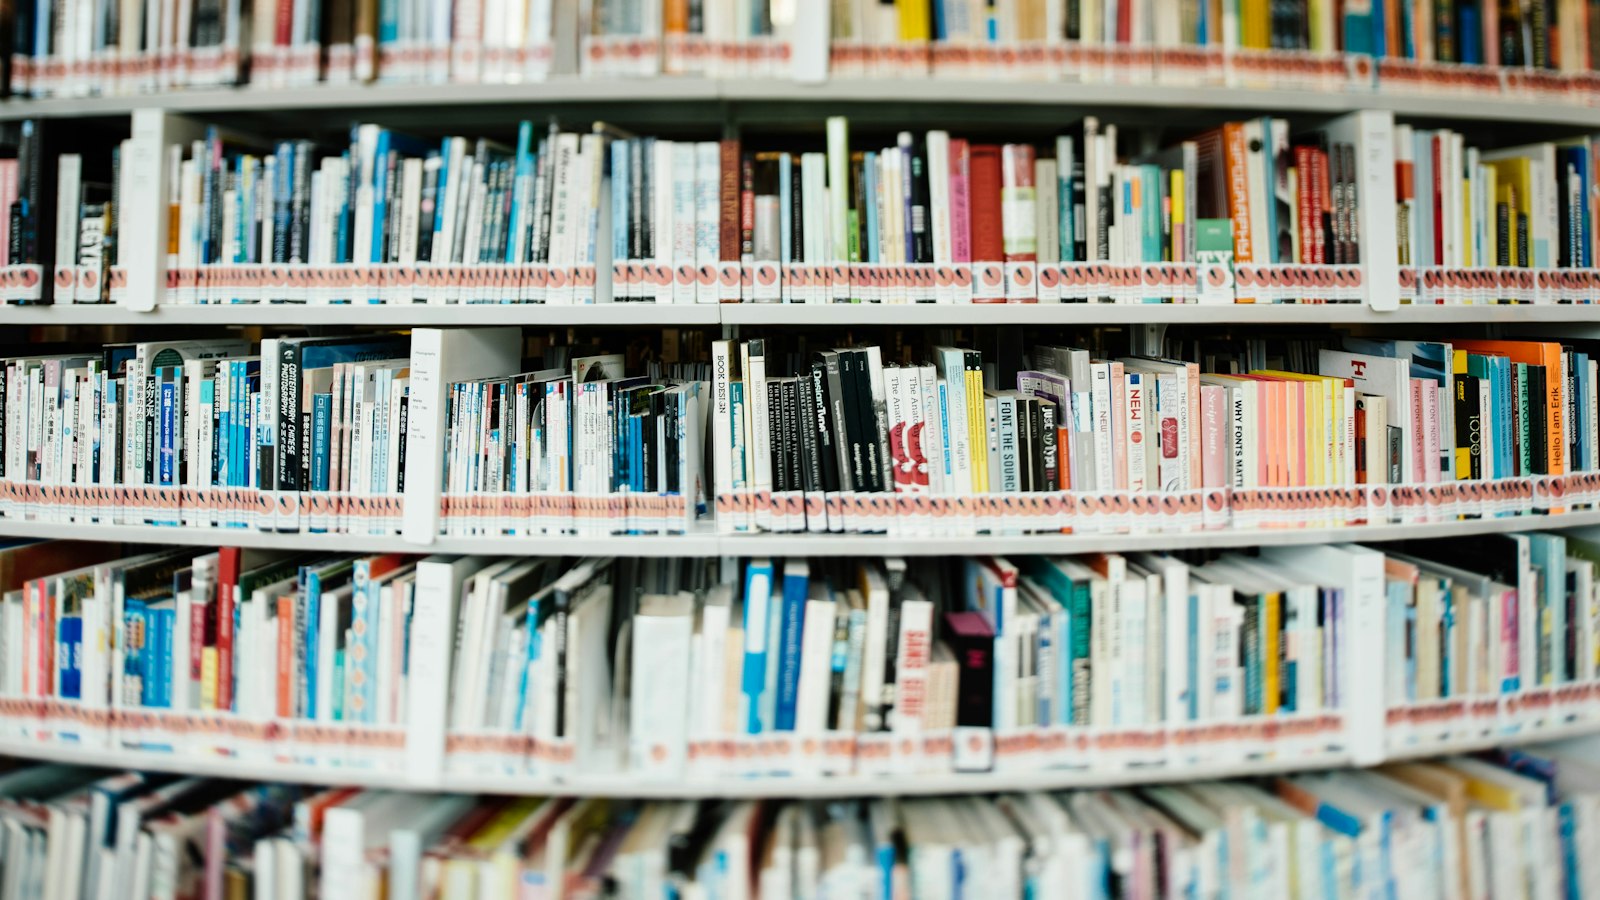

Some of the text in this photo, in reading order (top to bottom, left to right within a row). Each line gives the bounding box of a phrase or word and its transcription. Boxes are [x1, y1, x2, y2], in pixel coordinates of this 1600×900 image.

[717, 355, 727, 415] BOOK DESIGN
[891, 376, 900, 395] The
[909, 376, 918, 395] The
[925, 376, 934, 394] The
[1551, 387, 1560, 408] Erik
[287, 362, 297, 455] CONTEMPORARY CHINESE
[806, 396, 814, 429] ELEMENTS
[893, 398, 903, 438] Anatomy
[911, 397, 922, 438] Anatomy
[926, 395, 936, 440] Geometry
[1001, 402, 1012, 429] FONT.
[1130, 389, 1141, 420] NEW
[1235, 400, 1243, 422] WHY
[801, 408, 810, 449] BRINGHURST
[809, 429, 815, 438] OF
[1100, 410, 1108, 432] NEW
[1207, 392, 1219, 456] Script Fonts
[1521, 380, 1531, 472] THE EVOLUTION OF
[1553, 412, 1560, 428] am
[776, 432, 782, 441] OF
[791, 432, 797, 441] OF
[897, 441, 904, 449] of
[916, 441, 922, 449] of
[931, 442, 938, 451] of
[1002, 432, 1014, 450] THE
[1235, 425, 1243, 456] FONTS
[776, 442, 784, 488] TYPOGRAPHIC
[810, 439, 818, 485] TYPOGRAPHIC
[955, 440, 967, 471] digital
[1553, 438, 1561, 466] Hello
